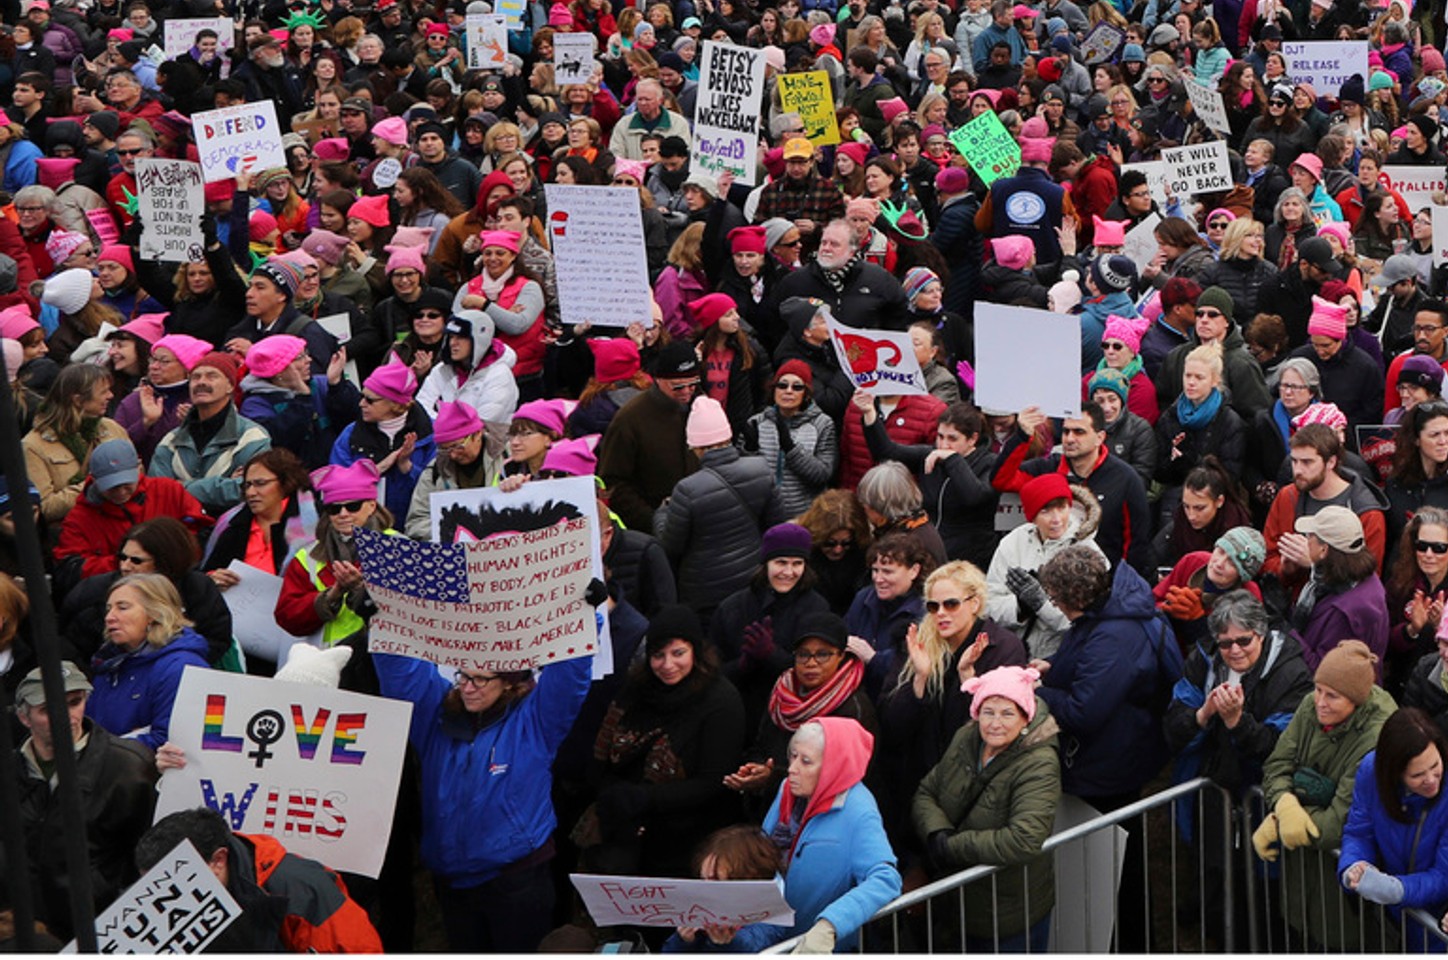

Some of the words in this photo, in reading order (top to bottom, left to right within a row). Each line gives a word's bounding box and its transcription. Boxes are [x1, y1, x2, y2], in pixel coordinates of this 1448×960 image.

[1285, 45, 1305, 55] DJT
[711, 46, 757, 74] BETSY
[1293, 60, 1341, 70] RELEASE
[708, 71, 754, 97] DEVOSS
[1323, 76, 1351, 86] TAXE
[711, 93, 742, 113] LIKES
[204, 114, 266, 141] DEFEND
[698, 106, 758, 135] NICKELBACK
[1166, 151, 1185, 164] WE
[1189, 146, 1219, 161] WILL
[1176, 161, 1217, 179] NEVER
[151, 186, 187, 200] GRABS
[1171, 180, 1189, 193] GO
[1195, 176, 1230, 191] BACK
[152, 198, 174, 210] FOR
[177, 199, 189, 210] UP
[152, 211, 174, 222] NOT
[175, 212, 194, 224] ARE
[156, 224, 192, 237] RIGHTS
[163, 240, 187, 251] OUR
[856, 369, 874, 385] NOT
[879, 369, 915, 385] YOURS
[521, 526, 561, 545] RIGHTS
[563, 516, 588, 533] ARE
[468, 555, 520, 574] HUMAN
[524, 541, 577, 562] RIGHTS
[470, 580, 485, 594] MY
[490, 573, 527, 592] BODY,
[528, 568, 550, 586] MY
[432, 600, 447, 613] IS
[453, 600, 514, 614] PATRIOTIC
[524, 588, 560, 608] LOVE
[563, 582, 577, 596] IS
[397, 608, 408, 621] IS
[411, 613, 438, 630] LOVE
[442, 618, 454, 631] IS
[454, 621, 485, 634] LOVE
[496, 616, 543, 633] BLACK
[547, 599, 584, 623] LIVES
[371, 617, 419, 639] MATTER
[424, 635, 488, 653] IMMIGRANTS
[491, 637, 524, 653] MAKE
[529, 617, 584, 649] AMERICA
[372, 639, 408, 655] GREAT
[421, 649, 439, 663] ALL
[444, 654, 468, 669] ARE
[473, 653, 542, 673] WELCOME
[199, 778, 348, 844] WINS
[96, 860, 189, 937] WANNA
[600, 882, 679, 900] FIGHT
[613, 900, 675, 916] LIKE
[689, 904, 717, 918] A
